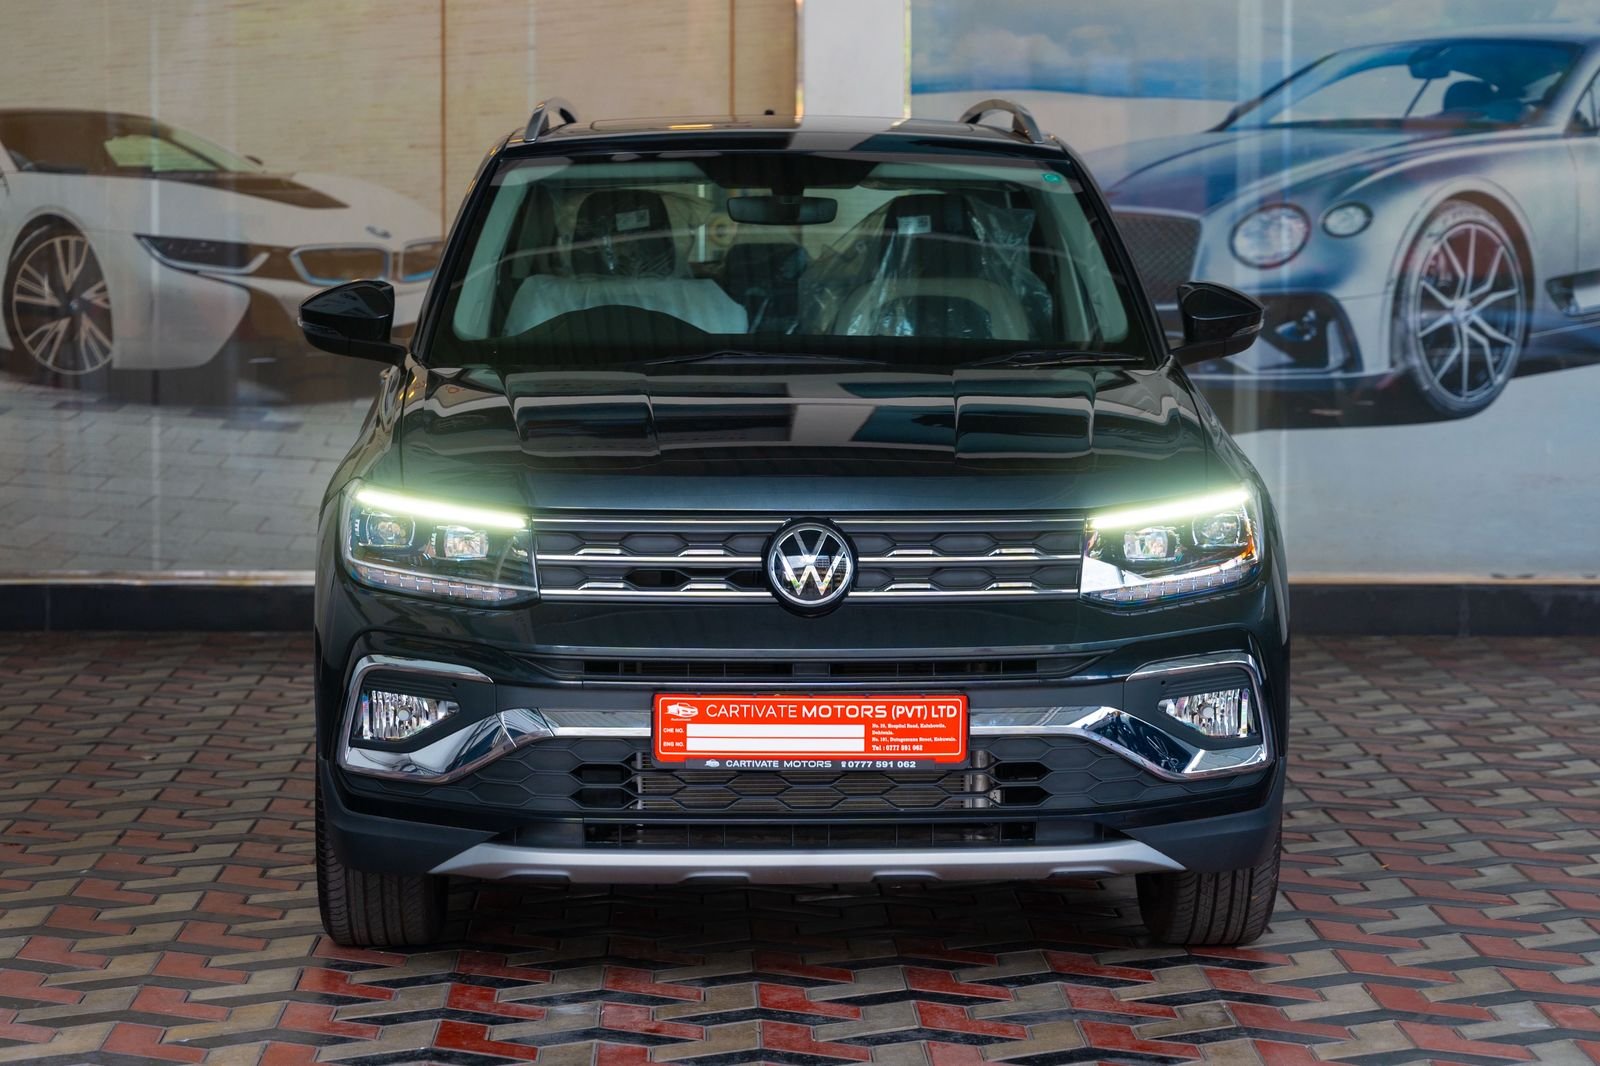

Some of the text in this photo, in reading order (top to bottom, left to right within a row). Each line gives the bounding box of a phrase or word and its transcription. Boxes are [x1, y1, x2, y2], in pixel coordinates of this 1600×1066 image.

[705, 704, 957, 720] CARTIVATE MOTORS (PVT) LTD
[726, 760, 916, 768] CARTIVATE MOTORS 0777 591 062
